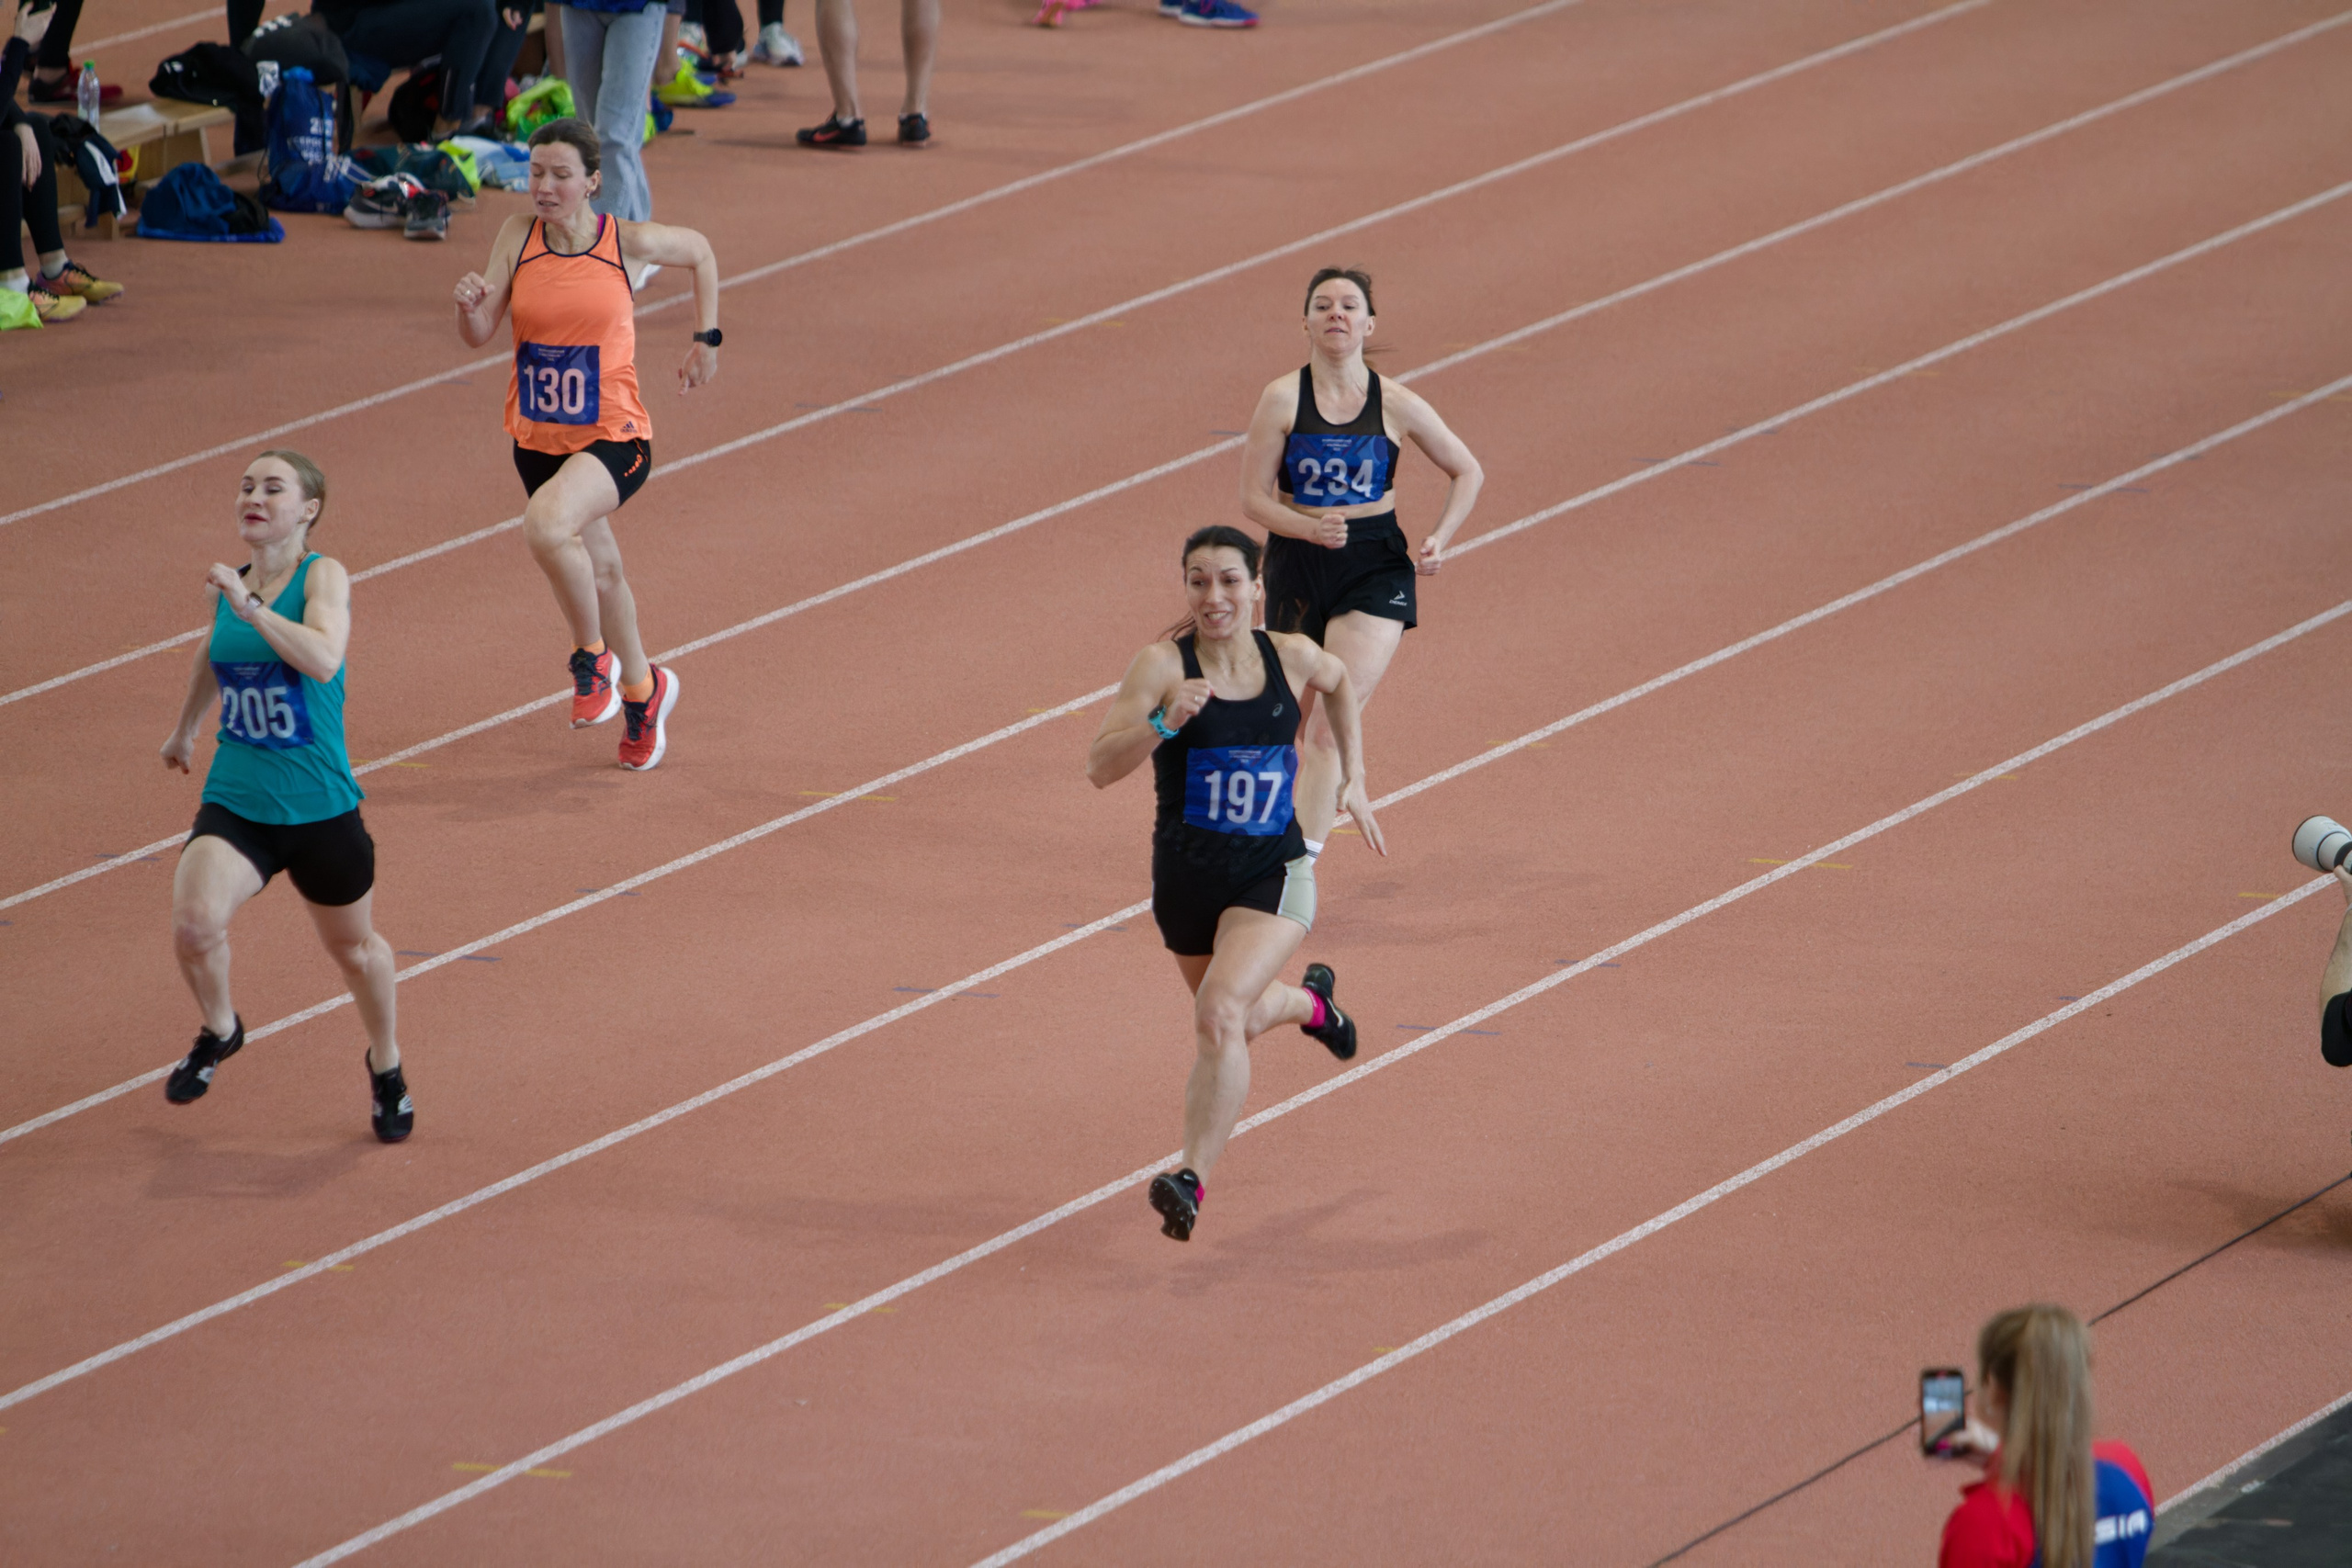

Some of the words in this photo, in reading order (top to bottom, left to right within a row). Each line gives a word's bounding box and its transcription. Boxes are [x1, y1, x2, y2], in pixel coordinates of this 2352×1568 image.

[524, 365, 585, 414] 130
[1298, 457, 1374, 498] 234
[222, 686, 296, 739] 205
[1204, 770, 1283, 824] 197
